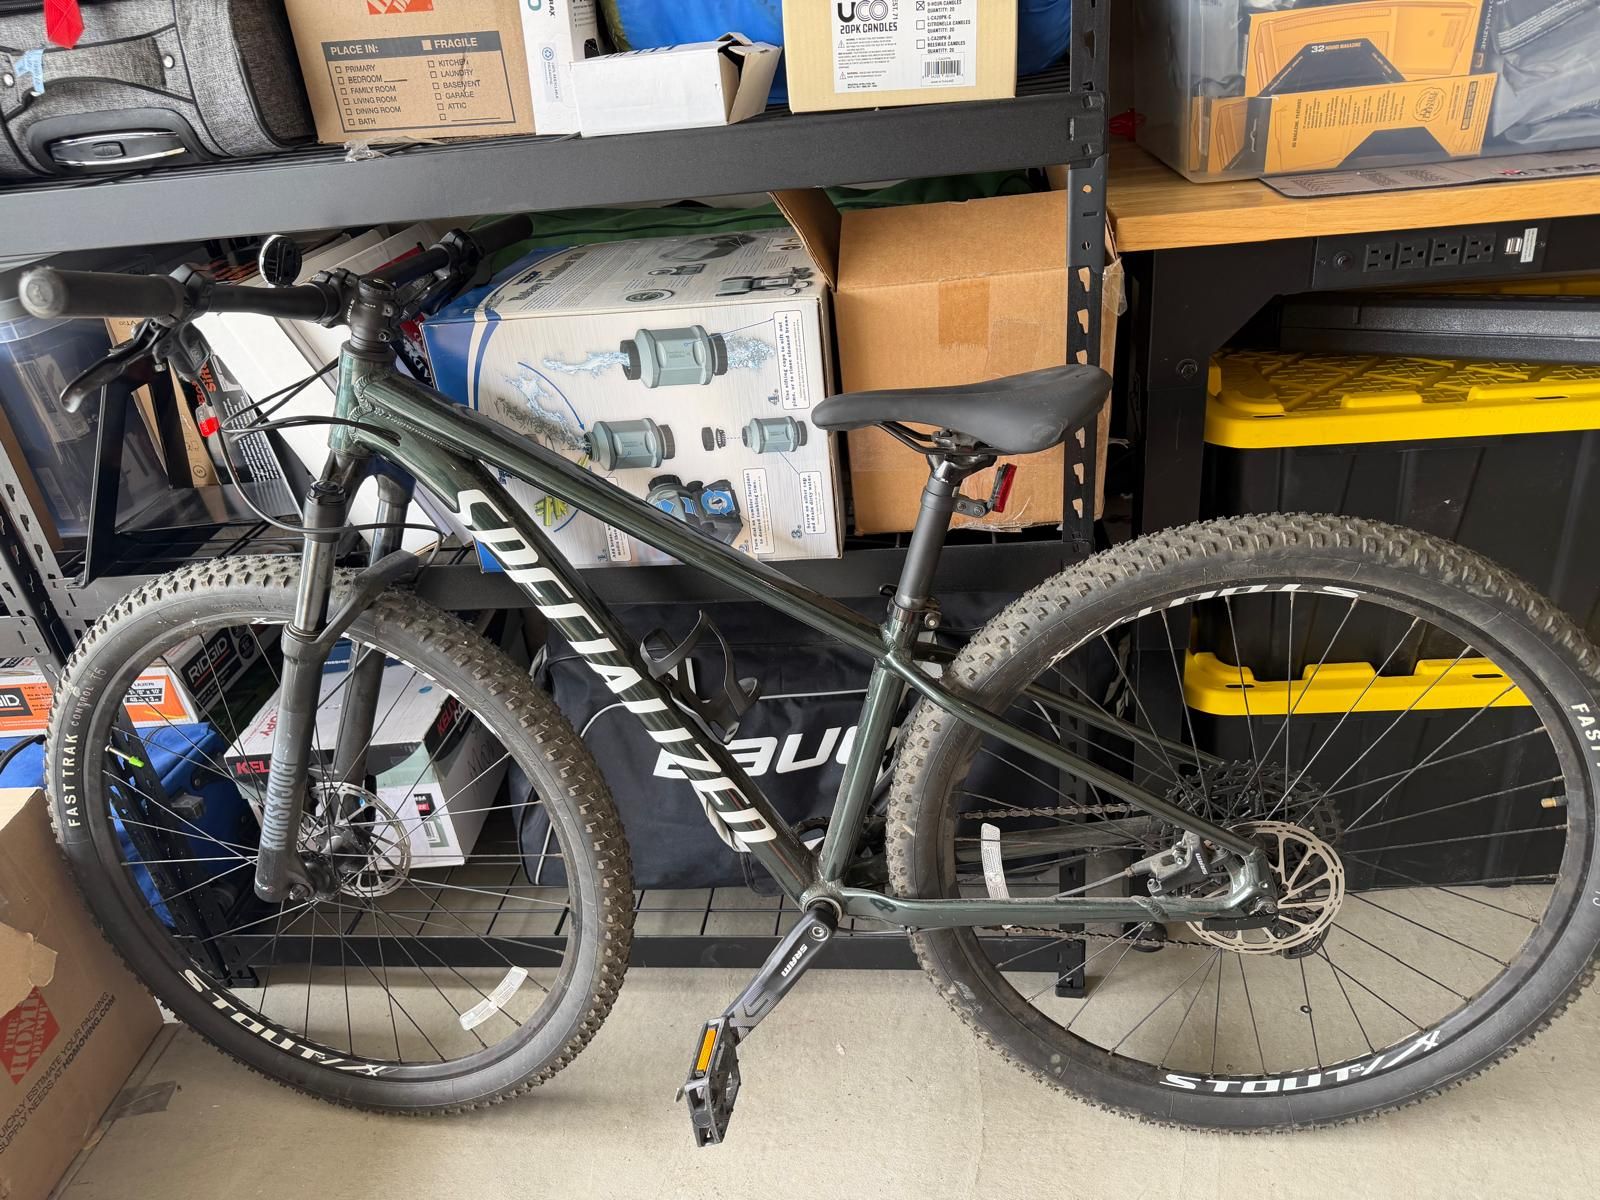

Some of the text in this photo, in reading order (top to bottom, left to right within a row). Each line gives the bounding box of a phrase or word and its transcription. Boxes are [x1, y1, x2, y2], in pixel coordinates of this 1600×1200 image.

[840, 22, 898, 35] 20PK CANDLES
[330, 44, 379, 56] PLACE IN:
[434, 37, 478, 50] FRAGILE
[1311, 44, 1325, 53] 32
[345, 64, 376, 74] PRIMARY
[438, 59, 470, 68] KITCHEN
[348, 75, 383, 85] BEDROOM
[440, 69, 474, 78] LAUNDRY
[350, 85, 397, 95] FAMILY ROOM
[443, 80, 481, 89] BASEMENT
[353, 95, 398, 105] LIVING ROOM
[445, 91, 475, 100] GARAGE
[355, 106, 402, 115] DINING ROOM
[447, 102, 467, 110] ATTIC
[358, 117, 376, 126] BATH
[187, 636, 228, 683] RIDGID
[457, 489, 777, 850] SPECIALIZED
[71, 686, 95, 727] CONTROL
[62, 734, 79, 777] TRAK
[236, 760, 271, 776] KEL
[62, 784, 81, 827] FAST
[261, 761, 297, 850] ROCKSHOX
[781, 943, 808, 977] SRAM
[4, 1017, 20, 1050] THE
[31, 1003, 49, 1058] DEPOT
[0, 991, 110, 1139] UICKLY ESTIMATE YOUR PACKING
[0, 995, 117, 1154] SUPPLY NEEDS AT HDMOVING.COM
